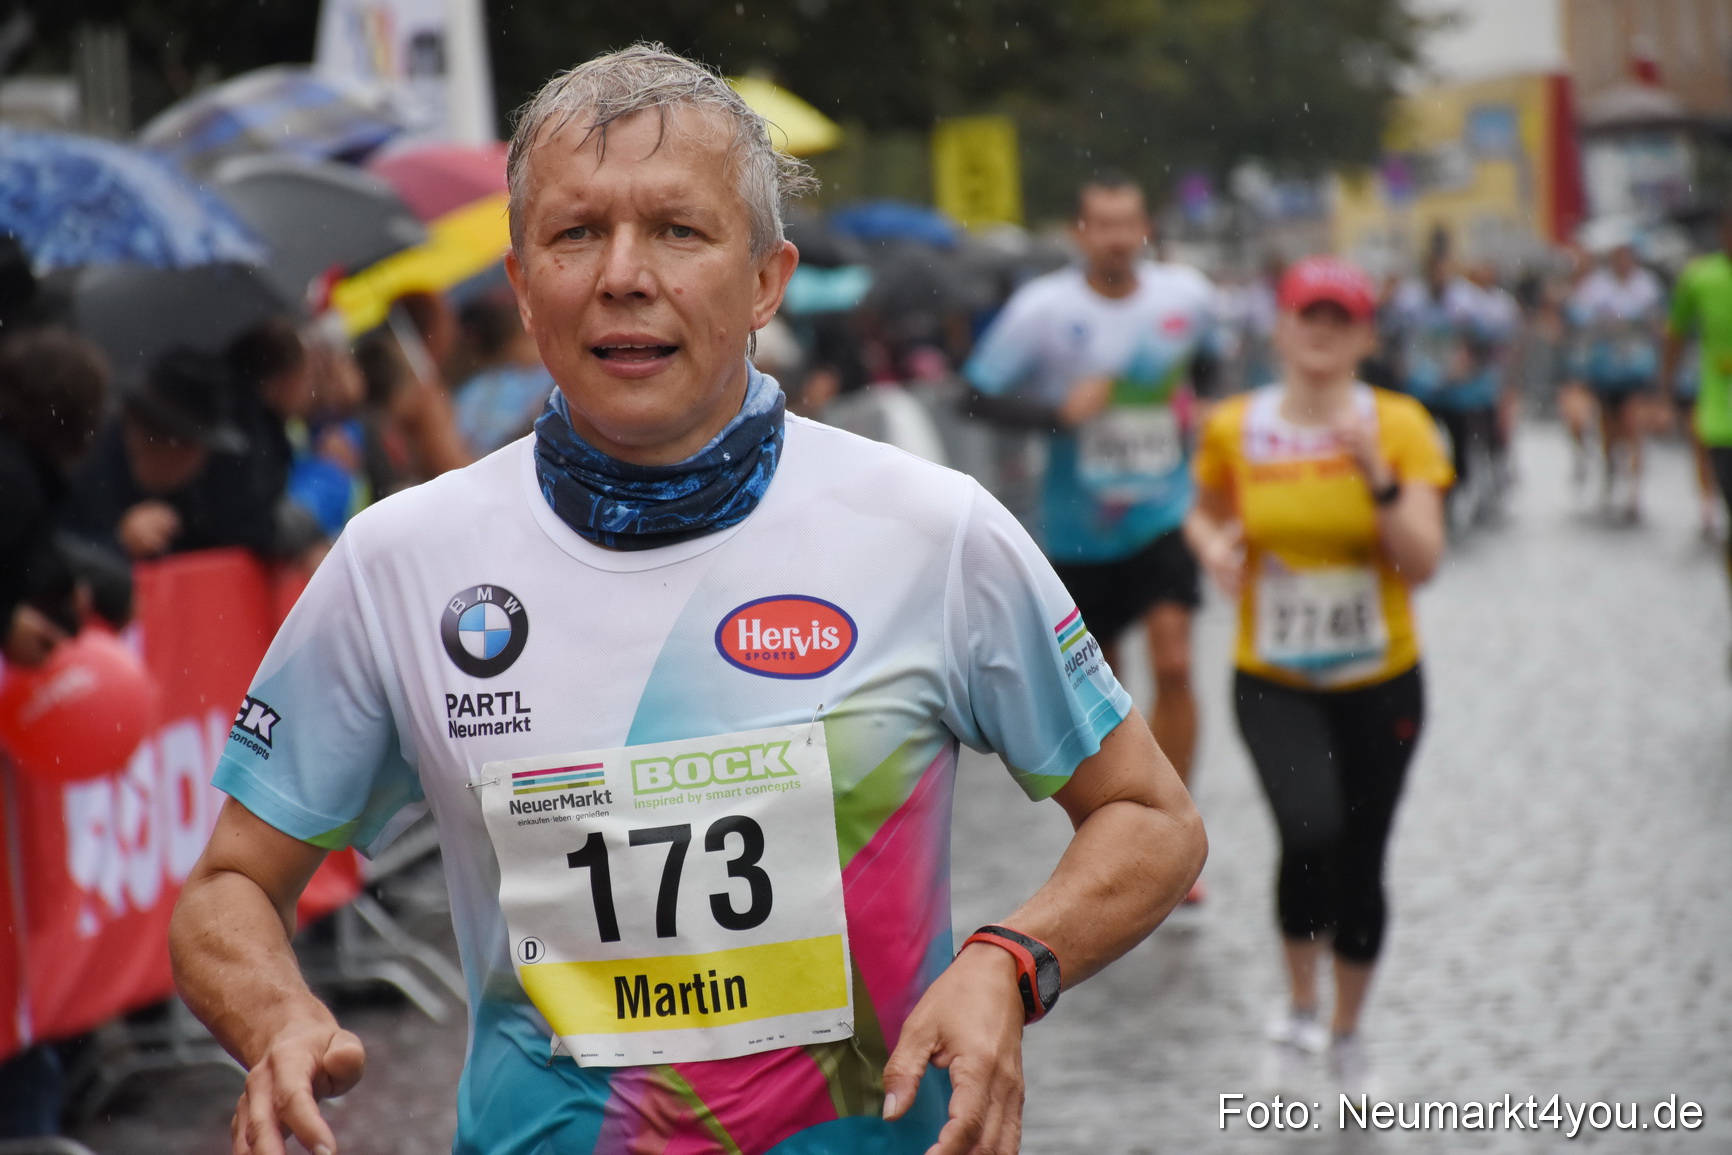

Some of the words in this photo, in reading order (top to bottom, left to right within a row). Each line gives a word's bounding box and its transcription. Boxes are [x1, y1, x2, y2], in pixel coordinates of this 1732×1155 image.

[449, 587, 522, 616] BMW
[737, 618, 840, 656] Hervis
[745, 651, 796, 661] SPORTS
[445, 691, 532, 718] PARTL
[448, 716, 532, 739] Neumarkt
[630, 740, 799, 796] BOCK
[509, 790, 613, 815] NeuerMarkt
[634, 794, 684, 810] inspired
[687, 793, 703, 804] by
[705, 787, 742, 801] smart
[745, 780, 801, 797] concepts
[566, 815, 773, 943] 173
[525, 941, 537, 960] D
[614, 969, 748, 1020] Martin
